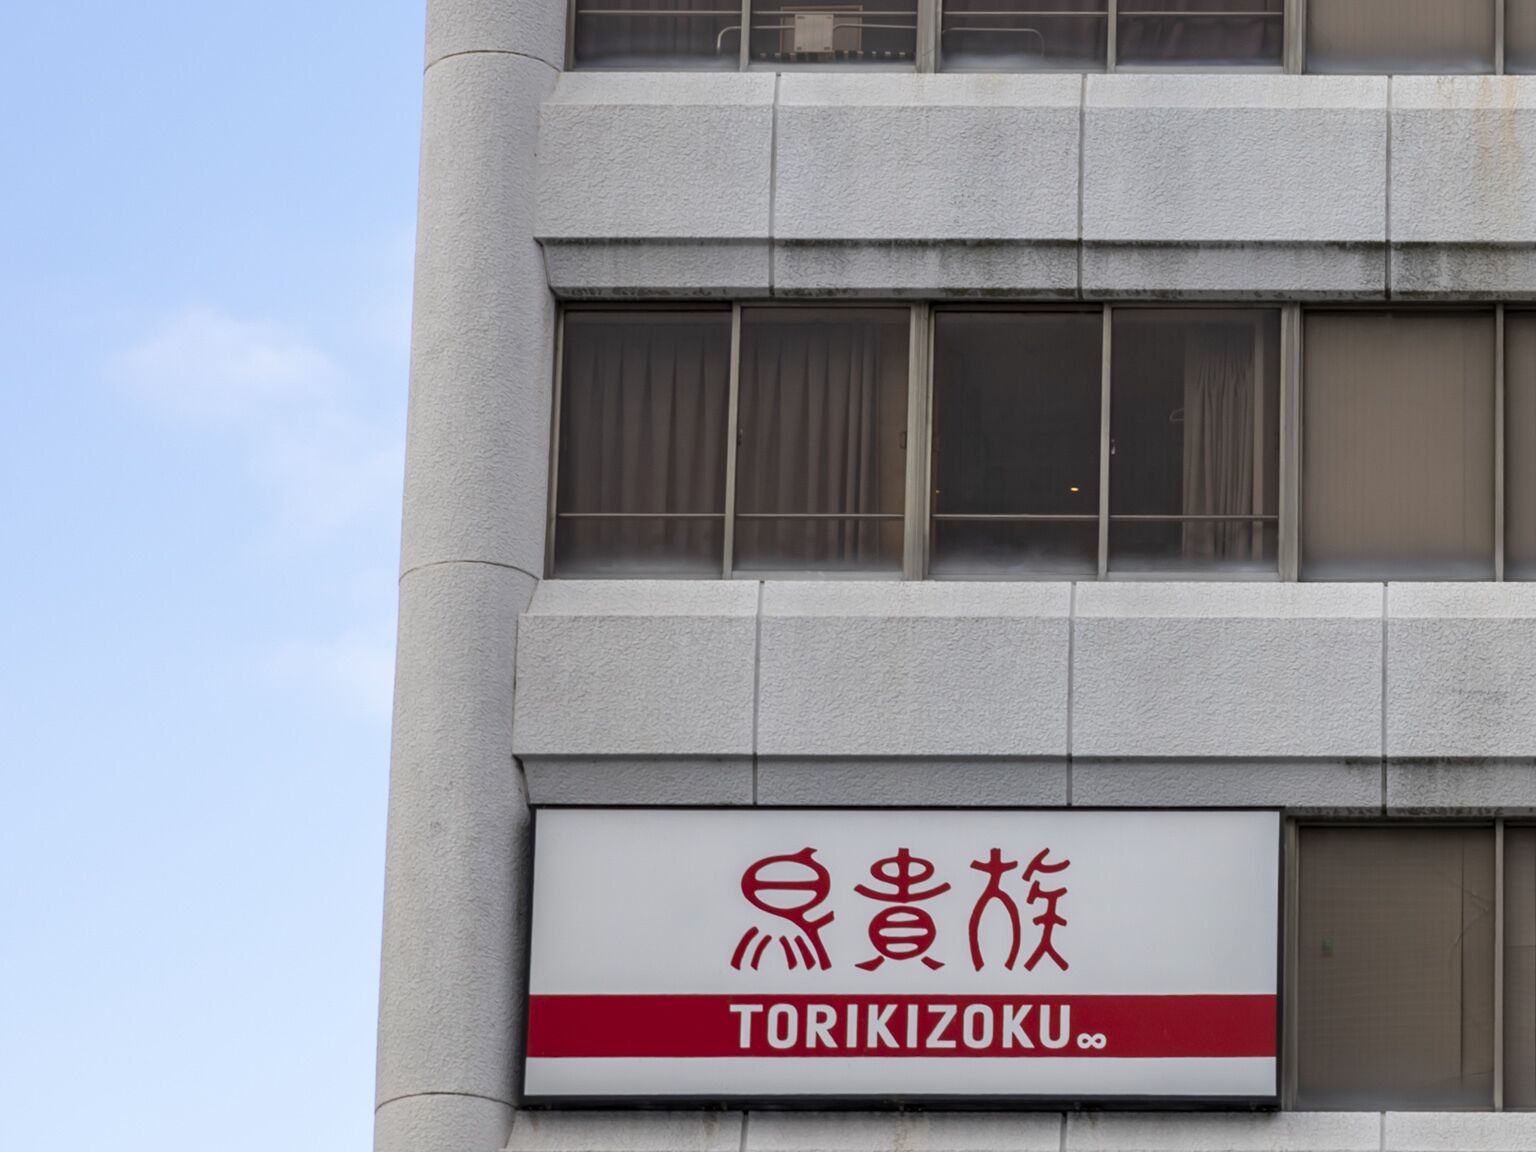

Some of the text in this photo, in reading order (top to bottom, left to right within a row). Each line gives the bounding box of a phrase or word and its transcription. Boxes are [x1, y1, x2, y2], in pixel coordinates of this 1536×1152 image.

[730, 847, 1071, 972] 鳥貴族
[729, 1003, 1071, 1049] TORIKIZOKU
